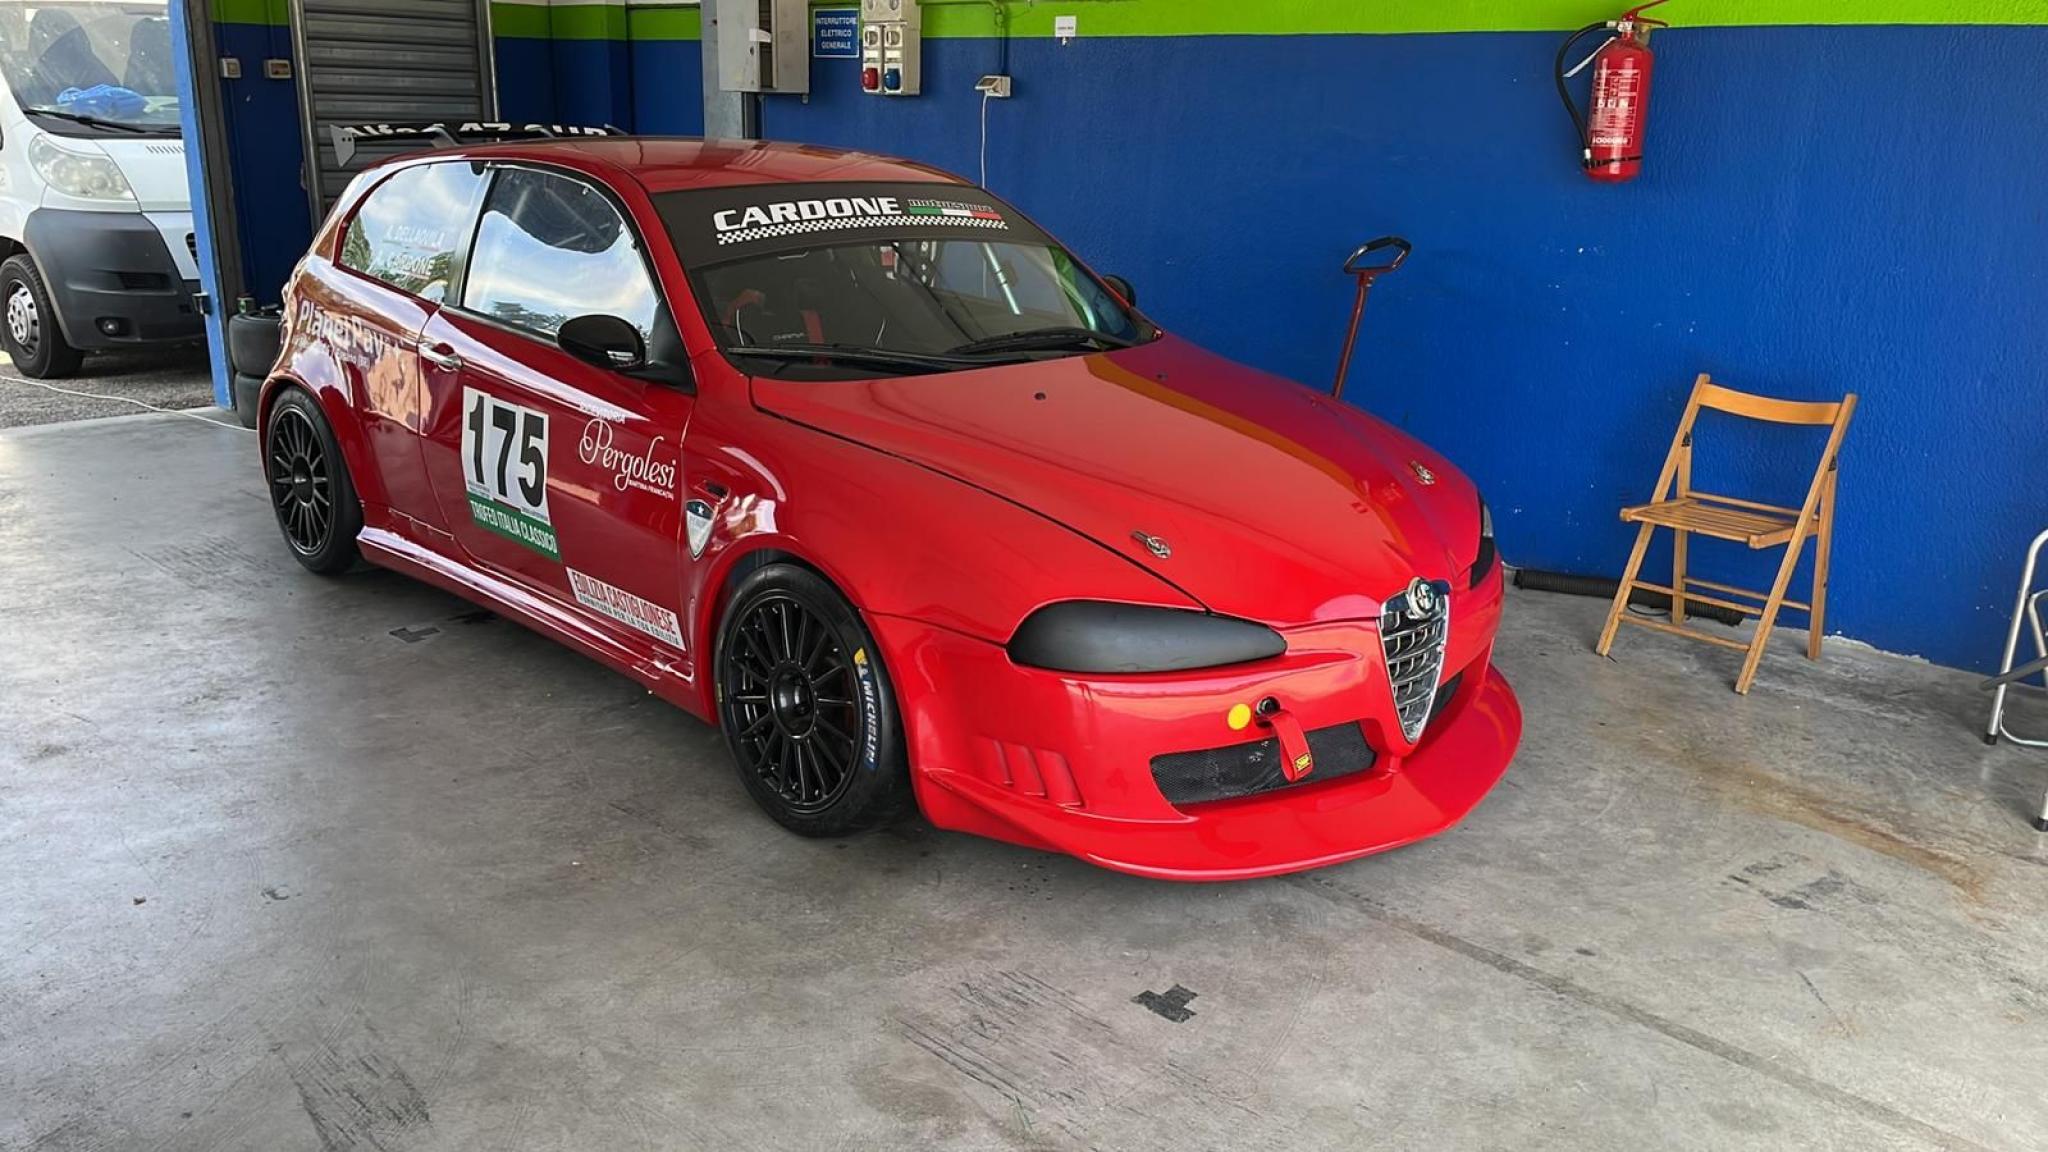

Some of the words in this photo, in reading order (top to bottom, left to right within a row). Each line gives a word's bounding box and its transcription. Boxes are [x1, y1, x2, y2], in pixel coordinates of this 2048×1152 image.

[816, 16, 858, 26] INTERRUTTORE
[820, 29, 852, 38] ELETTRICO
[820, 41, 852, 50] GENERALE
[713, 197, 902, 232] CARDONE
[469, 394, 545, 508] 175
[579, 418, 677, 491] Pergolesi
[470, 500, 499, 527] TROFEO
[498, 511, 522, 538] ITALIA
[520, 520, 558, 554] CLASSICO
[572, 571, 608, 604] EDILIZIA
[605, 585, 677, 635] CASTIGLIONESE
[862, 680, 878, 764] MICHELIN
